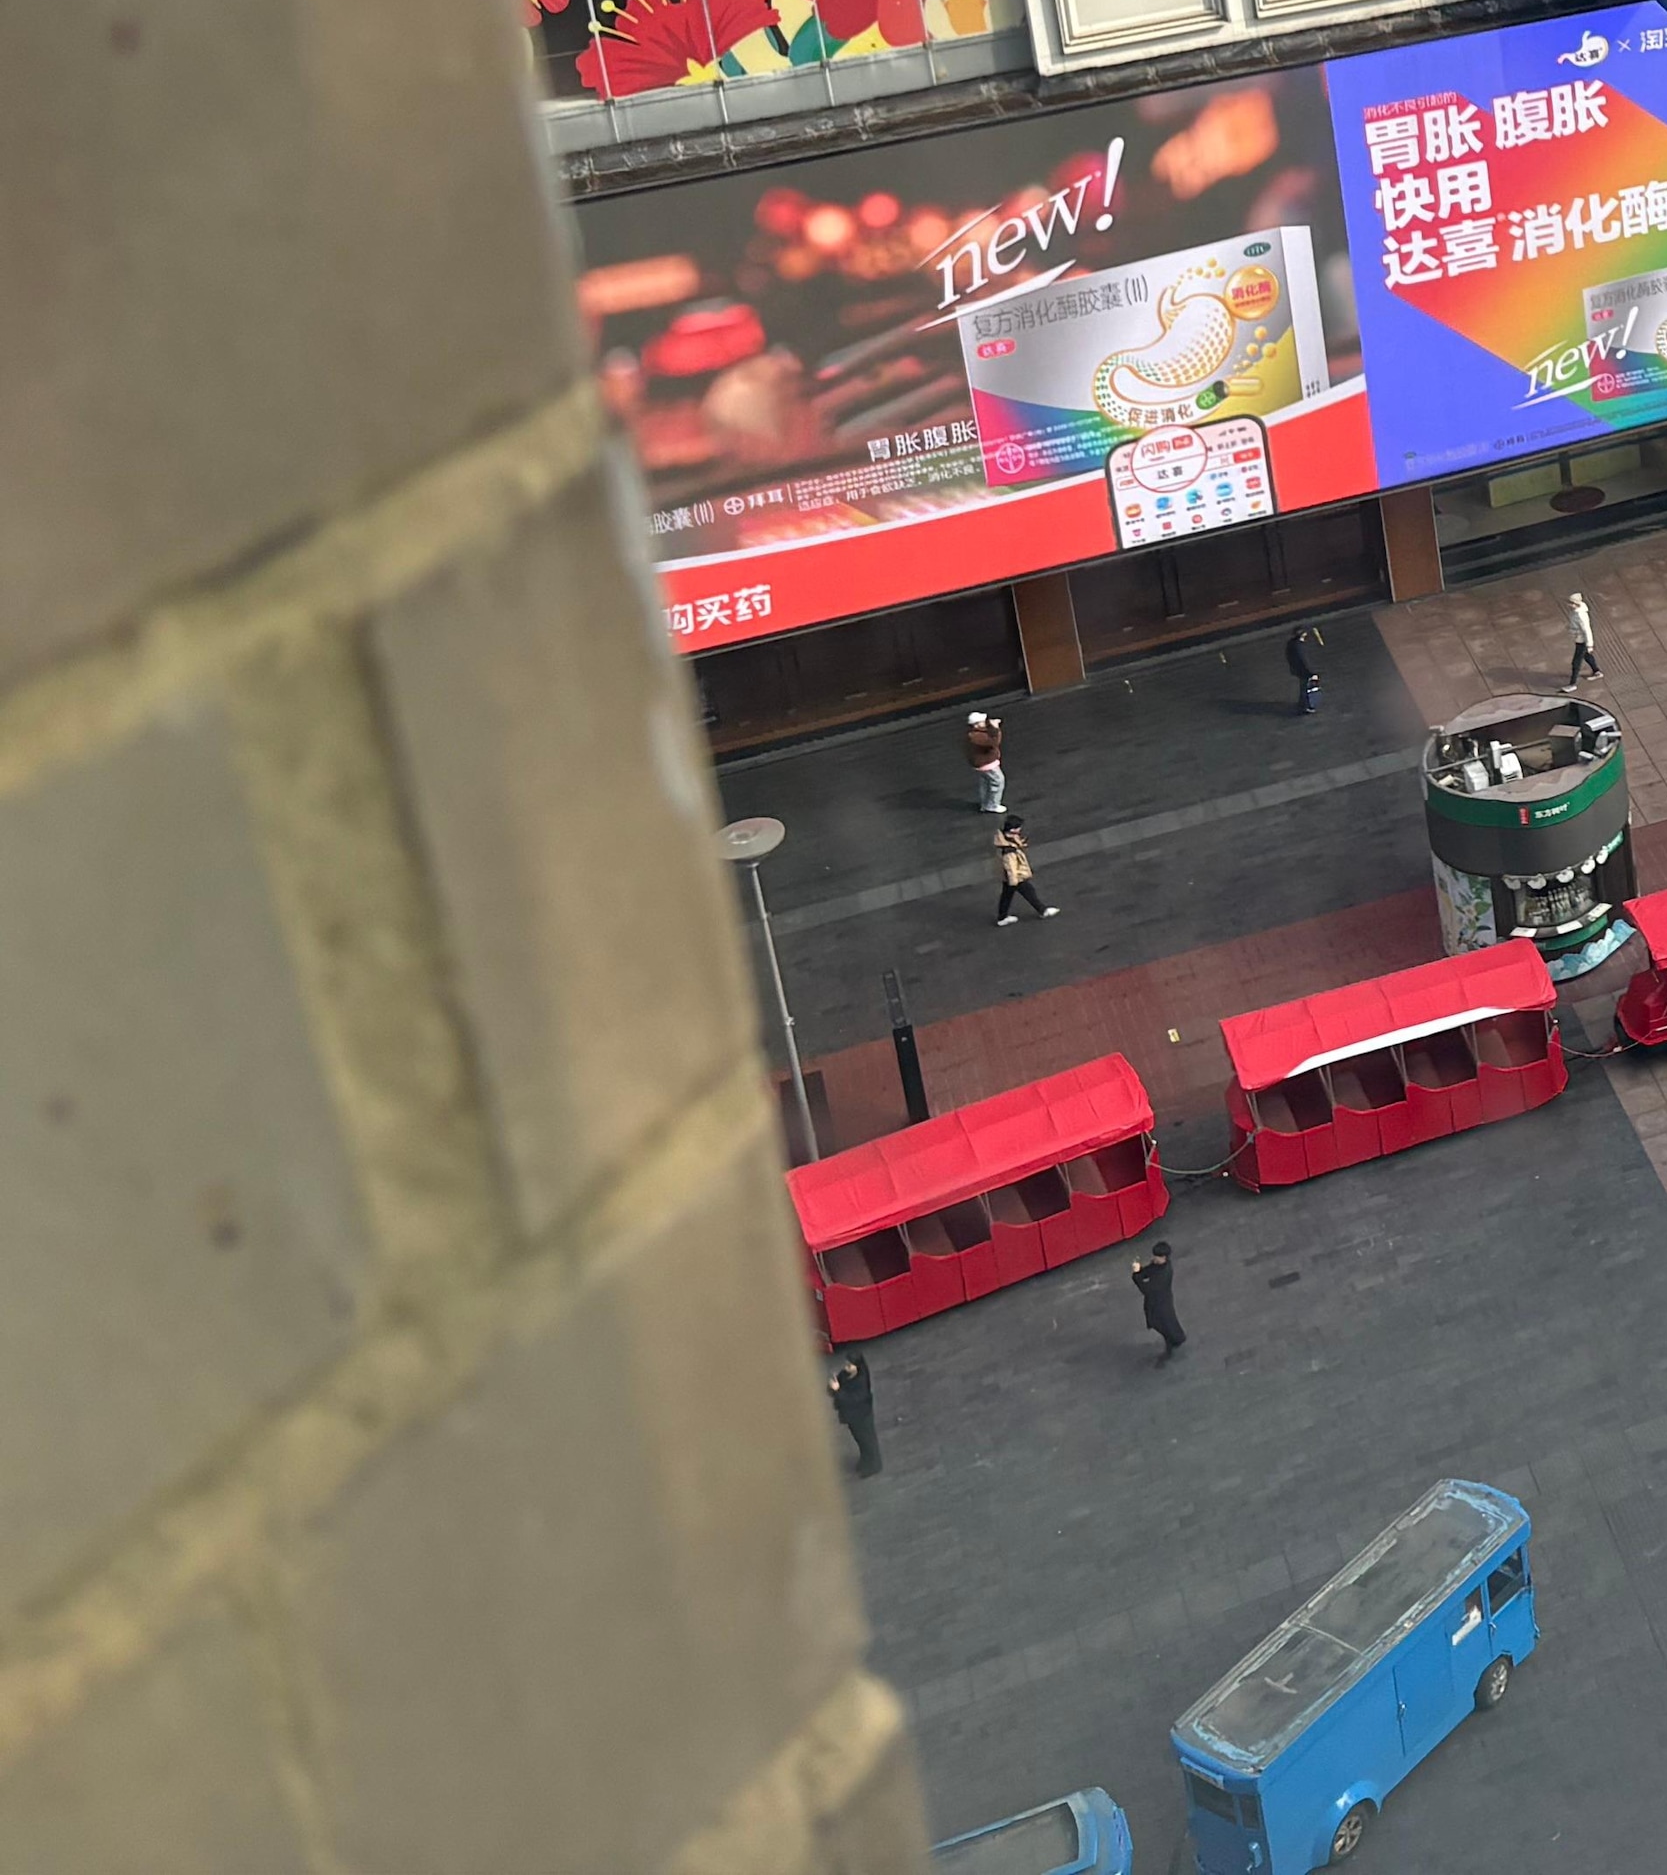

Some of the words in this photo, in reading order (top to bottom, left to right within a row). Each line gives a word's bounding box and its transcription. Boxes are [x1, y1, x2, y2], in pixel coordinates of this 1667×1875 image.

[1365, 105, 1483, 176] 胃胀
[1493, 79, 1609, 151] 腹胀
[934, 136, 1126, 312] new!
[1375, 160, 1491, 229] 快用
[1382, 219, 1500, 290] 达喜
[1525, 306, 1639, 397] new!
[867, 419, 977, 462] 胃胀腹胀
[650, 500, 715, 536] 胶囊(II)
[748, 488, 784, 509] 拜耳
[664, 583, 773, 636] 购买药
